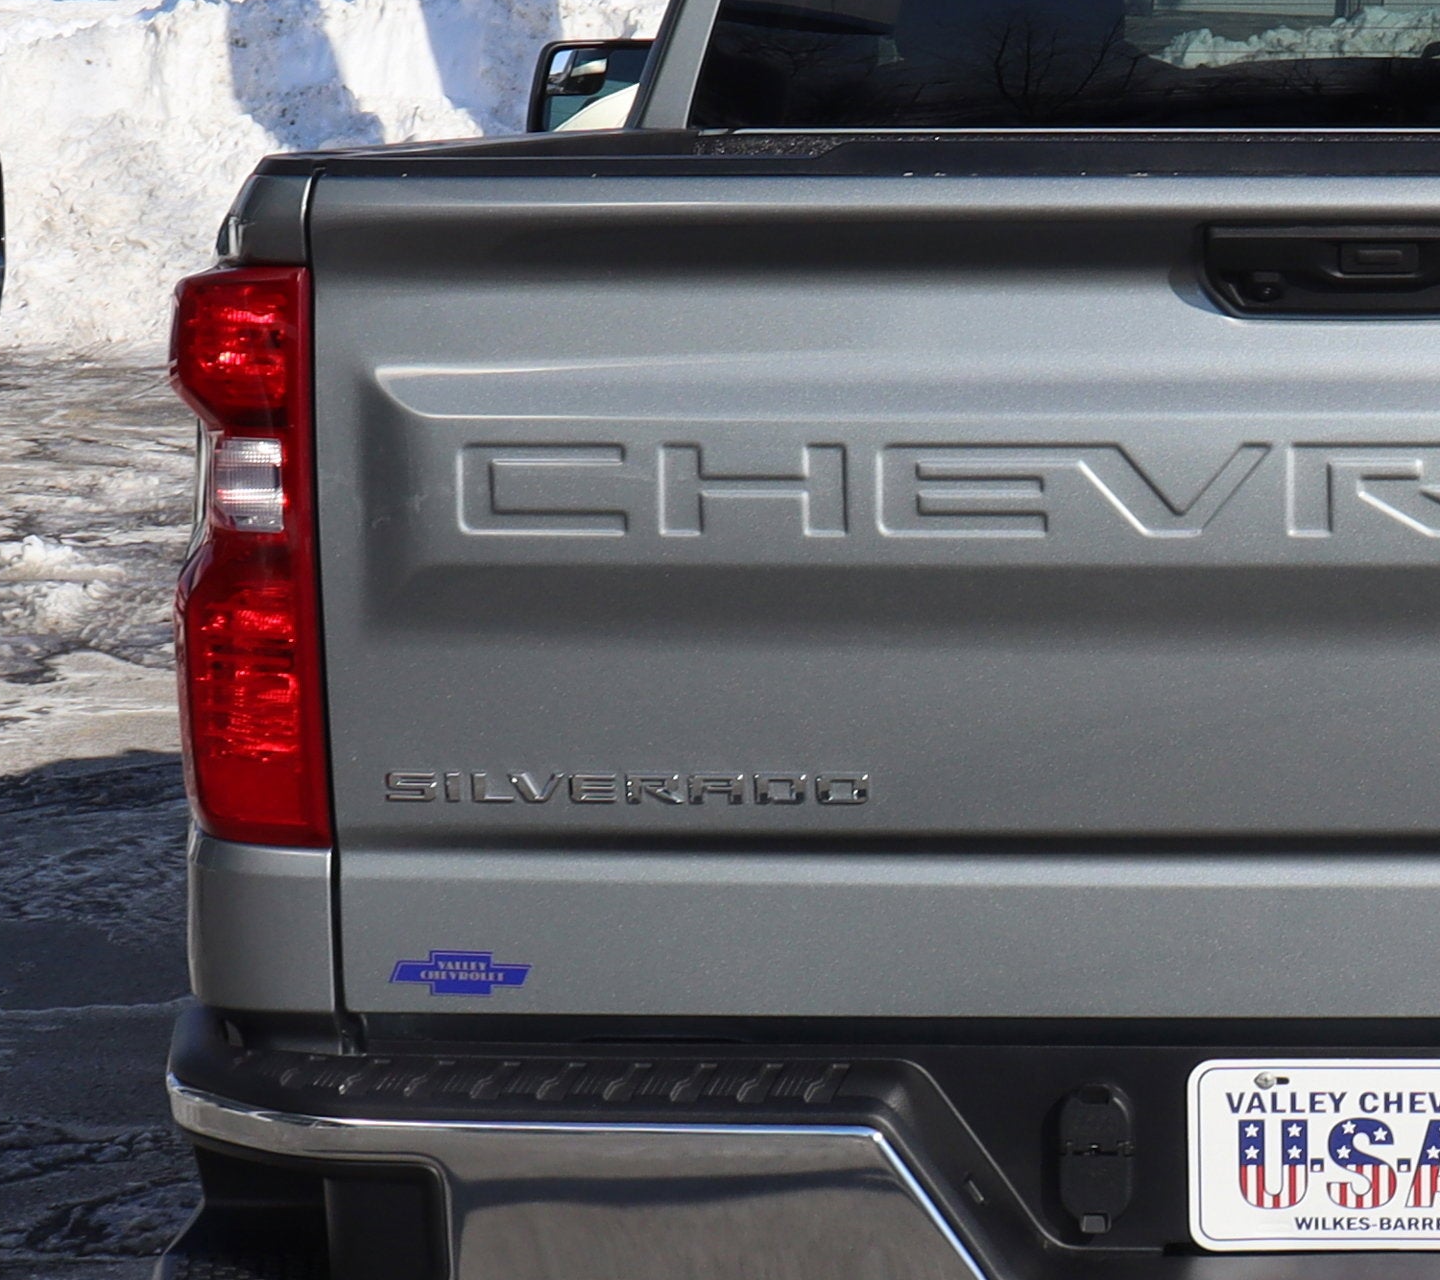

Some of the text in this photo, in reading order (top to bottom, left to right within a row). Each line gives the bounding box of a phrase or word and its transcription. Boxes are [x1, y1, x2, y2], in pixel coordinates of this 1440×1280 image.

[385, 770, 871, 806] SILVERADO
[437, 961, 487, 970] VALLEY
[420, 971, 504, 981] CHEVROLET
[1225, 1091, 1348, 1114] VALLEY
